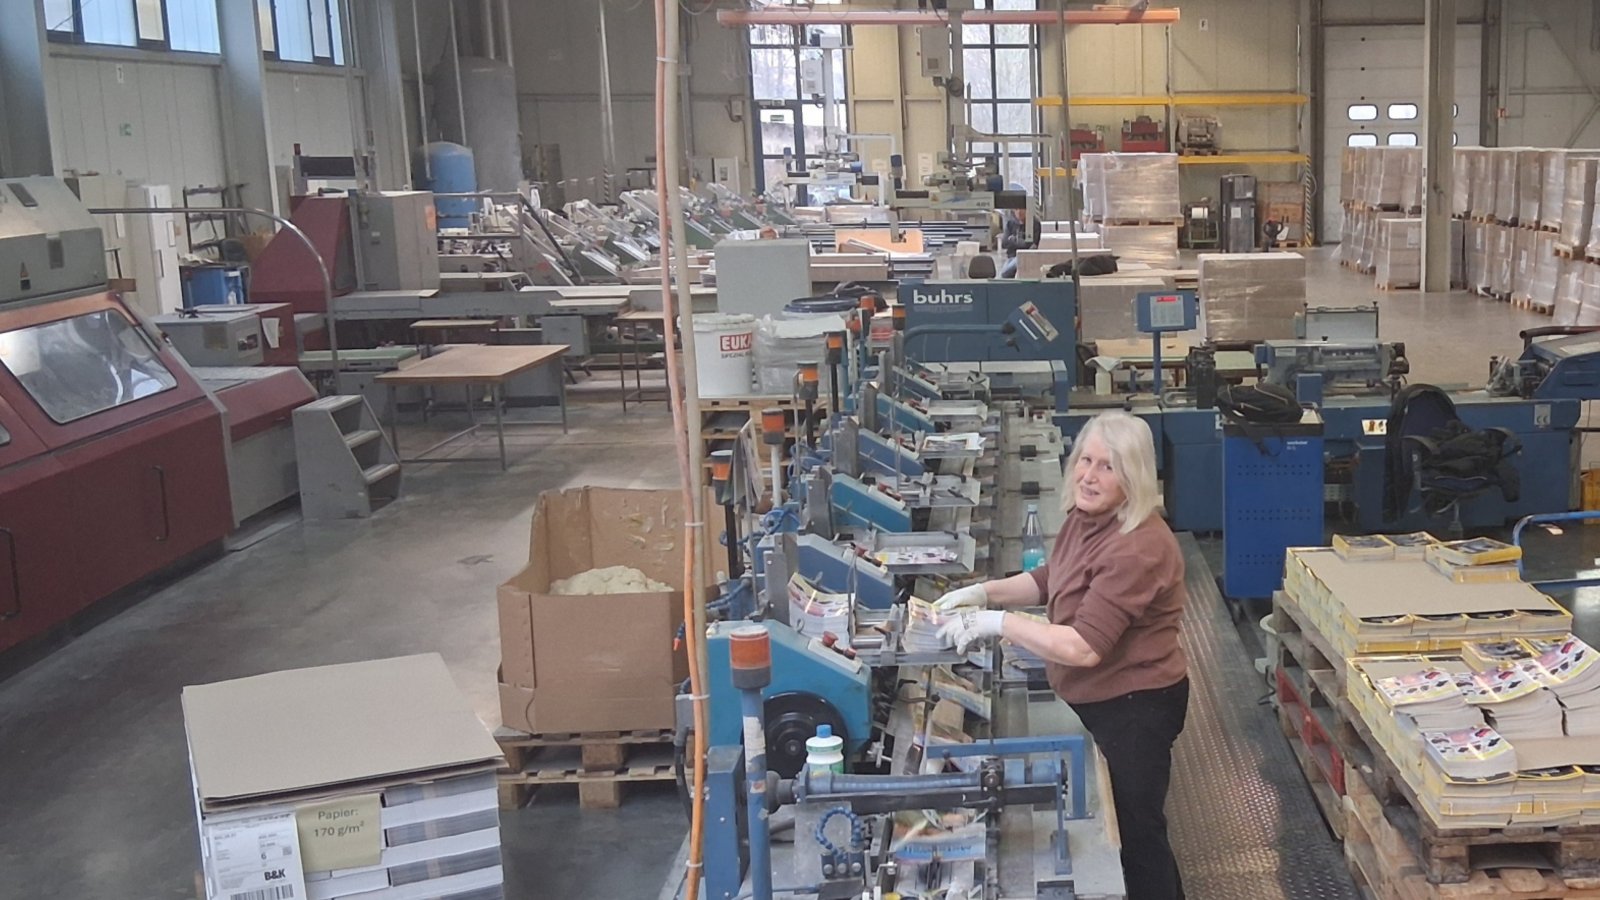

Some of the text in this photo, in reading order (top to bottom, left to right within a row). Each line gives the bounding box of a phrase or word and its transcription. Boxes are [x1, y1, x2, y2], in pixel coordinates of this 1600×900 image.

[913, 289, 973, 304] buhrs
[318, 809, 360, 820] Papier:
[314, 826, 335, 837] 170
[264, 868, 286, 881] B&K
